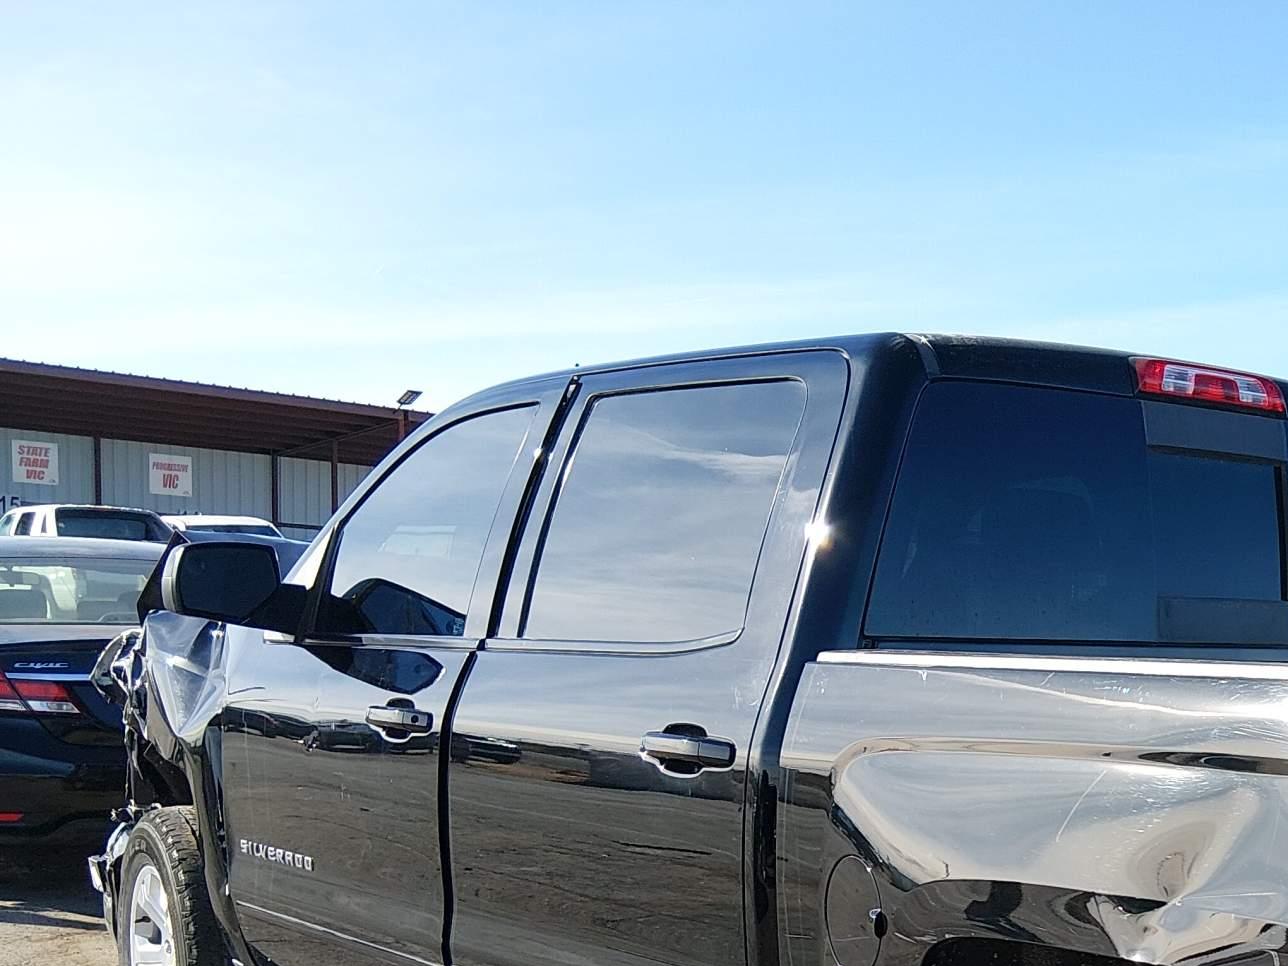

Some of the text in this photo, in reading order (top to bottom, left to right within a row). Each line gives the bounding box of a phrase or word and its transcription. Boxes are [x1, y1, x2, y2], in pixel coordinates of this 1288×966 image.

[17, 445, 51, 457] STATE
[18, 456, 50, 469] FARM
[152, 461, 189, 473] PROGRESSIVE
[25, 469, 46, 481] VIC
[162, 474, 180, 489] VIC
[239, 839, 313, 872] SILVERADO
